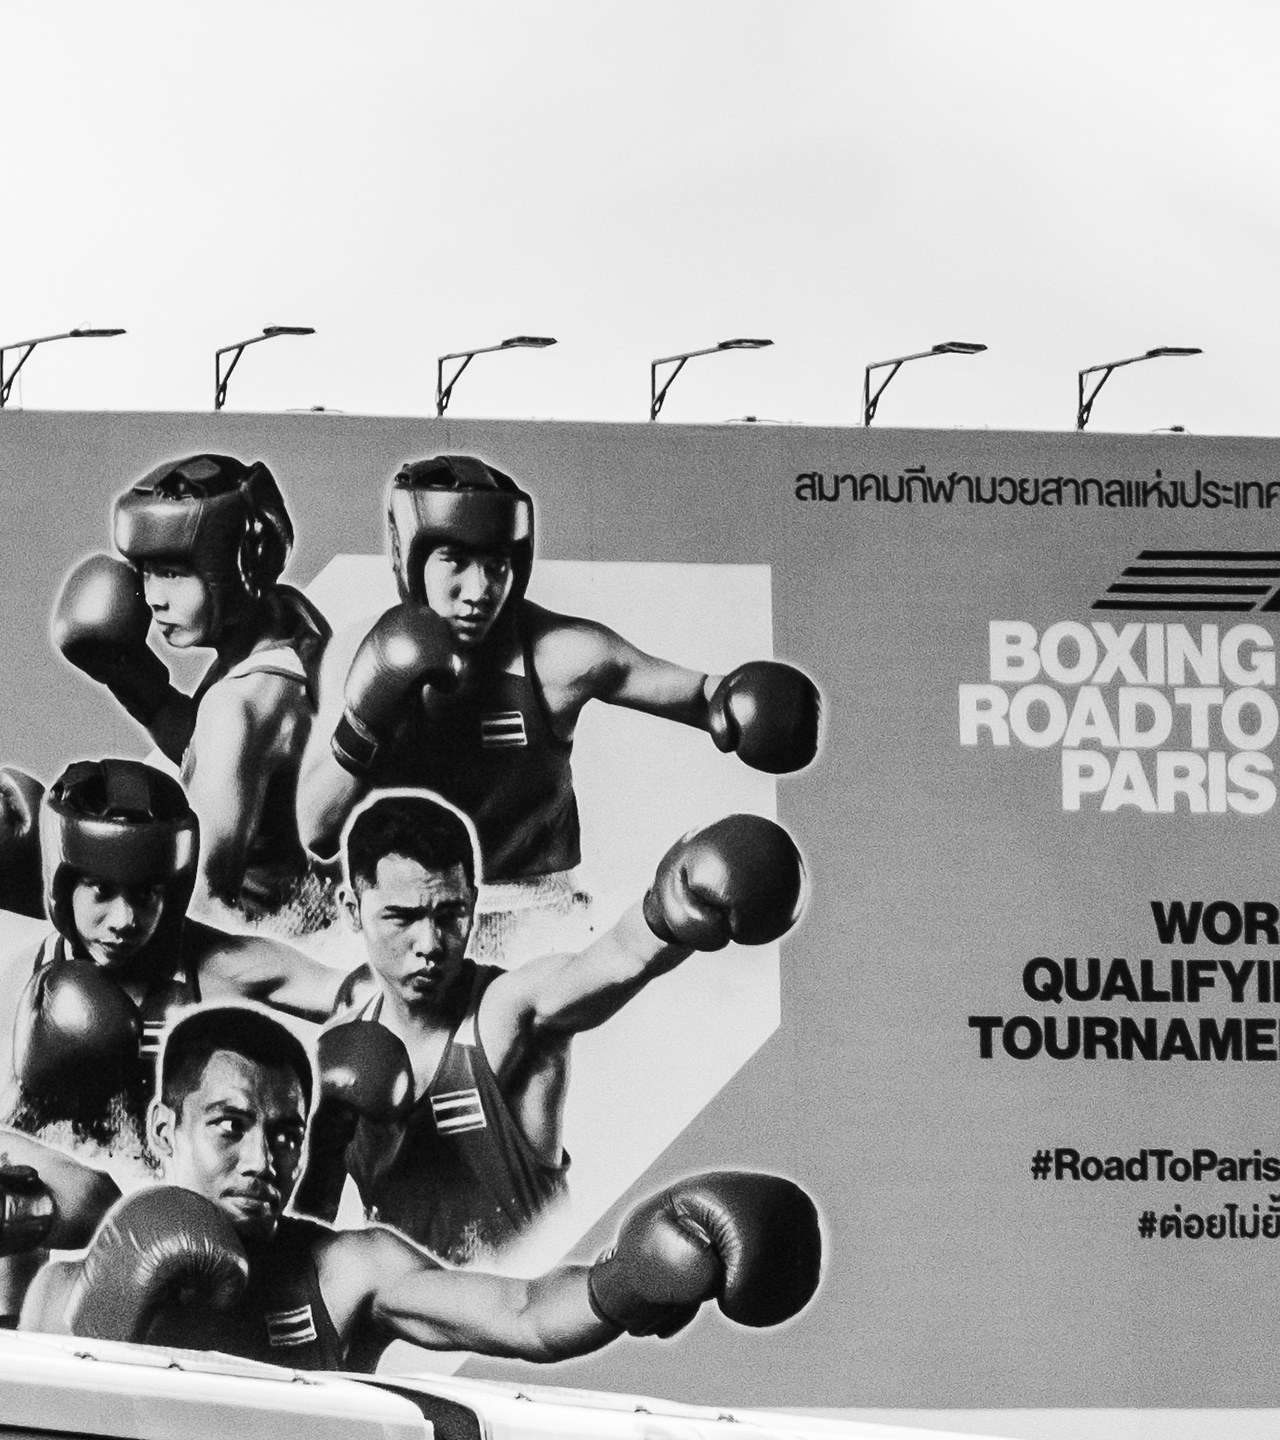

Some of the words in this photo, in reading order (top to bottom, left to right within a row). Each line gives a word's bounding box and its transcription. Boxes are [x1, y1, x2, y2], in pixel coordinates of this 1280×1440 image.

[990, 620, 1277, 686] BOXING
[958, 683, 1173, 748] ROAD
[1174, 687, 1279, 751] TO
[1061, 749, 1278, 814] PARIS
[1022, 956, 1280, 1004] QUALIFYI
[968, 1015, 1280, 1061] TOURNAME
